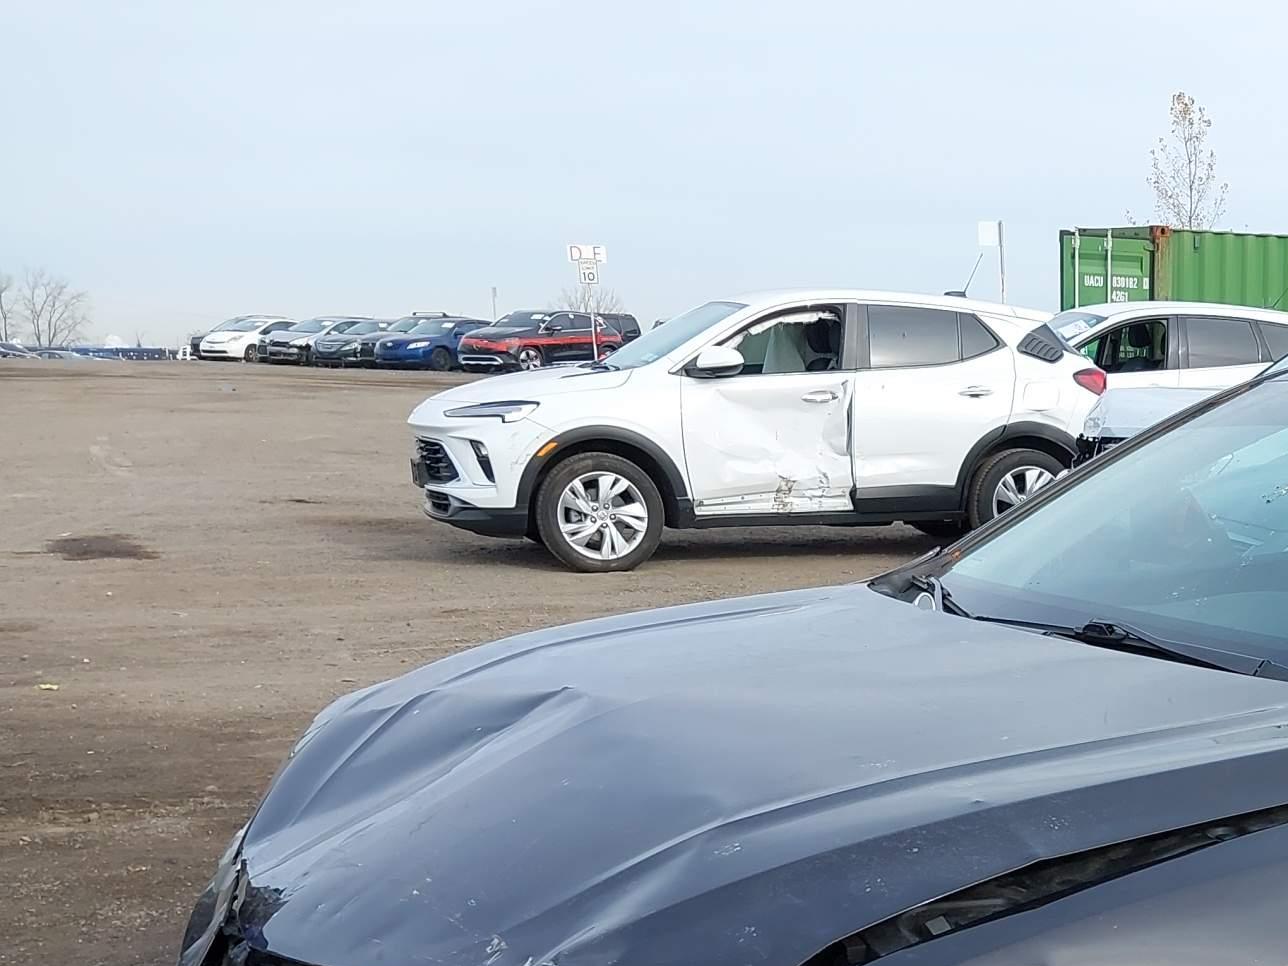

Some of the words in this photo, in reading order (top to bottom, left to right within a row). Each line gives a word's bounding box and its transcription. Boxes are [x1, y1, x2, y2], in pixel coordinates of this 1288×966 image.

[570, 246, 581, 261] D
[583, 272, 595, 281] 10
[1084, 275, 1104, 287] UACU
